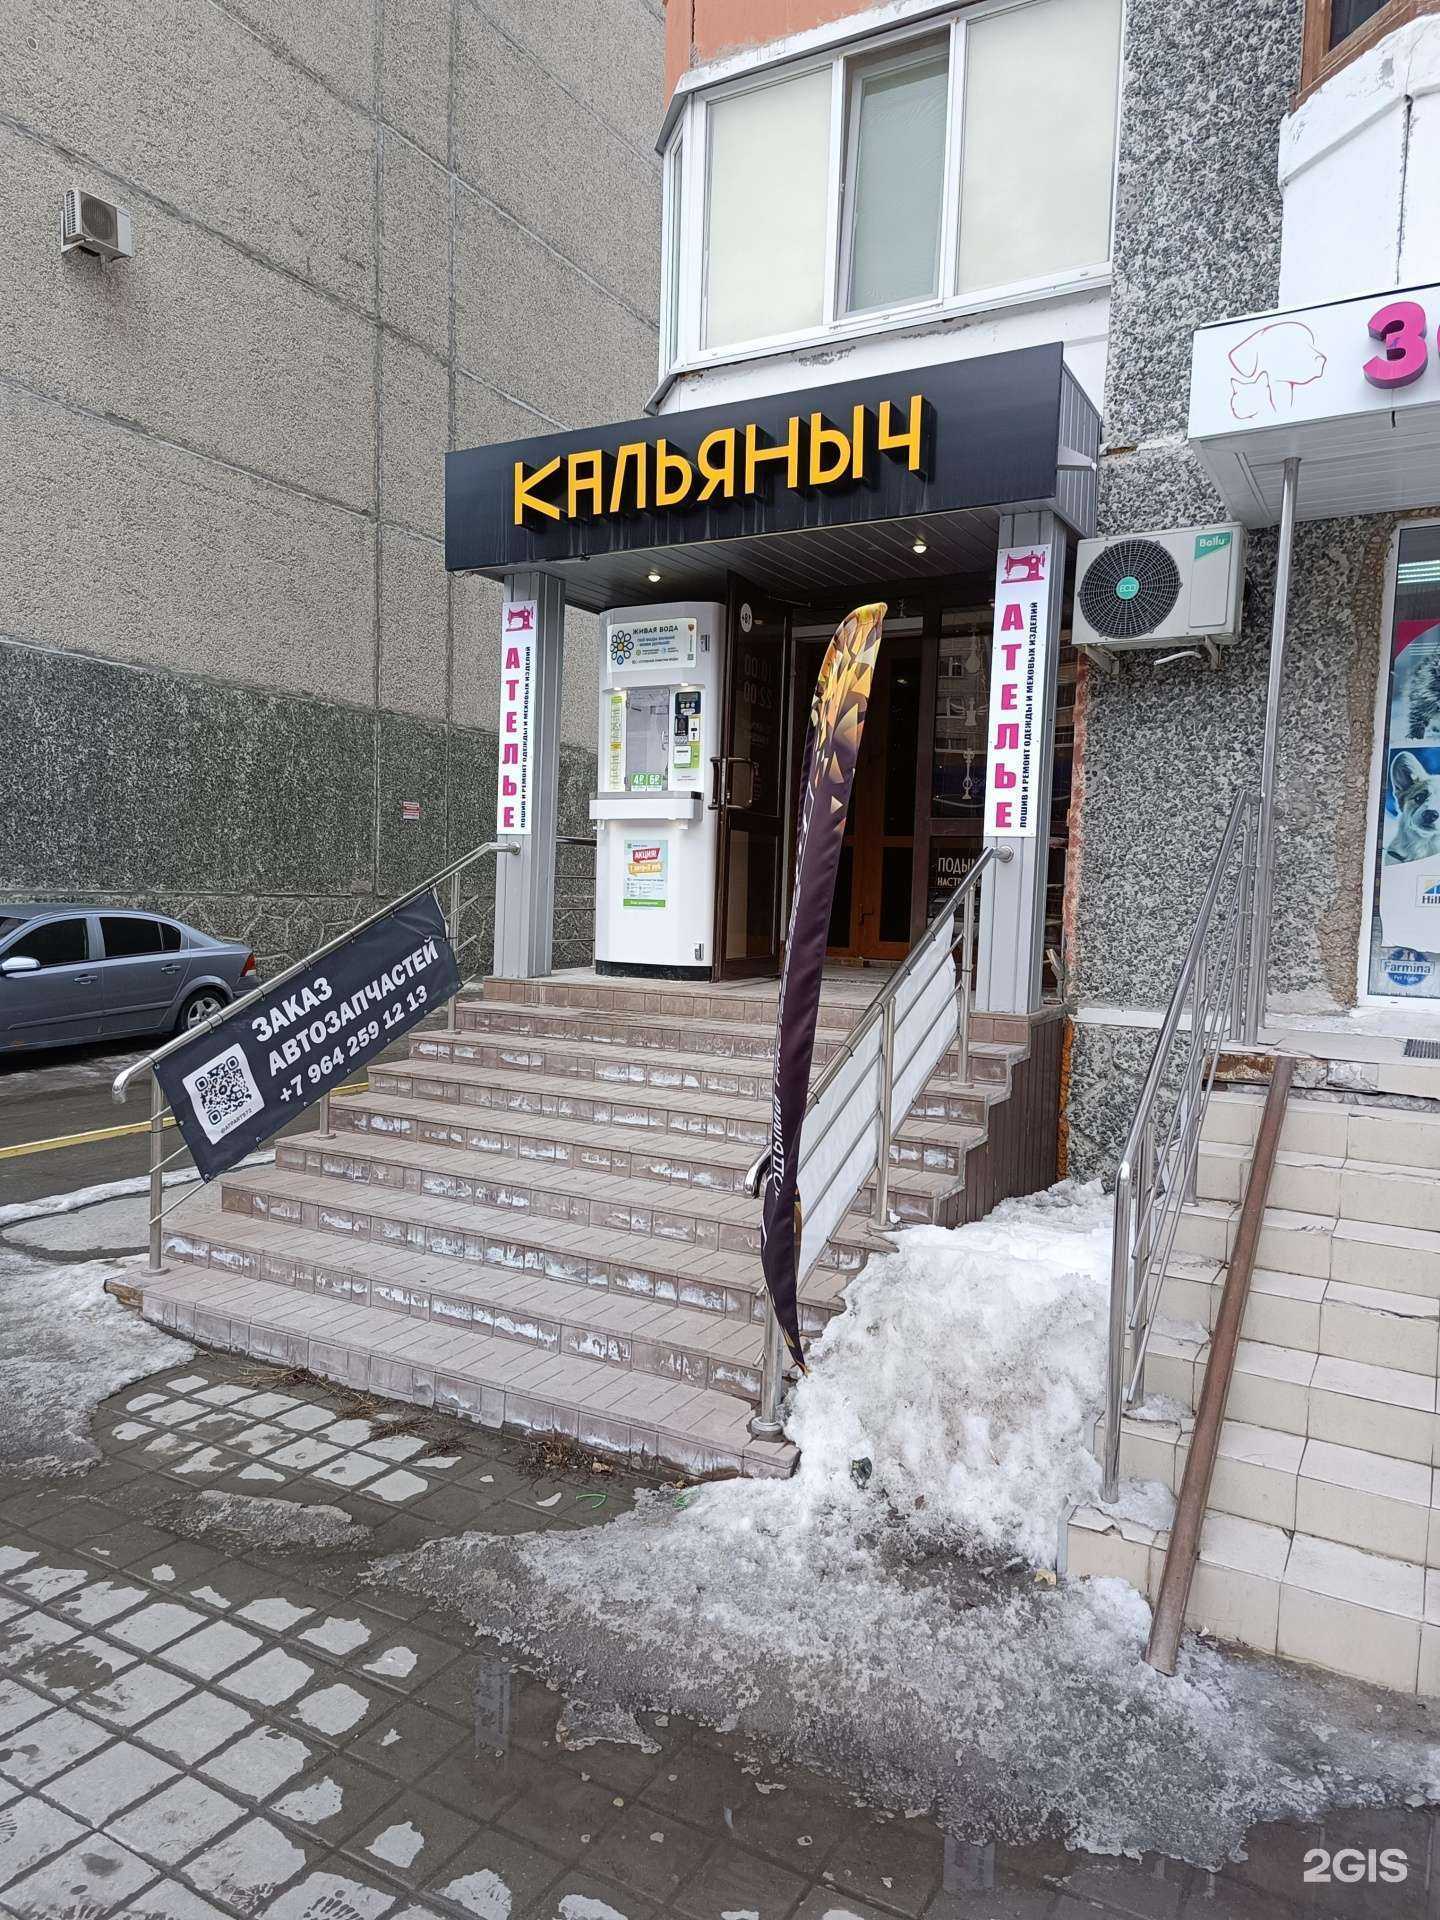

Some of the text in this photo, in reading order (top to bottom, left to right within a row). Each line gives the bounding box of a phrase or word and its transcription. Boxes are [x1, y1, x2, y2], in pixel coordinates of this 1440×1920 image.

[1363, 302, 1440, 388] З
[514, 394, 922, 525] КАЛЬЯНЫЧ
[1200, 536, 1226, 547] Ballu
[633, 625, 679, 635] ЖИВАЯ ВОДА
[502, 647, 520, 828] АТЕЛЬЕ
[994, 604, 1024, 828] АТЕЛЬЕ
[1020, 602, 1037, 828] ПОШИВ И РЕМОНТ ОДЕЖДЫ И МЕХОВЫХ ИЗДЕЛИЙ
[252, 977, 333, 1042] ЗАКАЗ
[269, 936, 439, 1077] АВТОЗАПЧАСТЕЙ
[1384, 961, 1431, 973] Farmina
[280, 985, 428, 1102] +7 964 259 12 13
